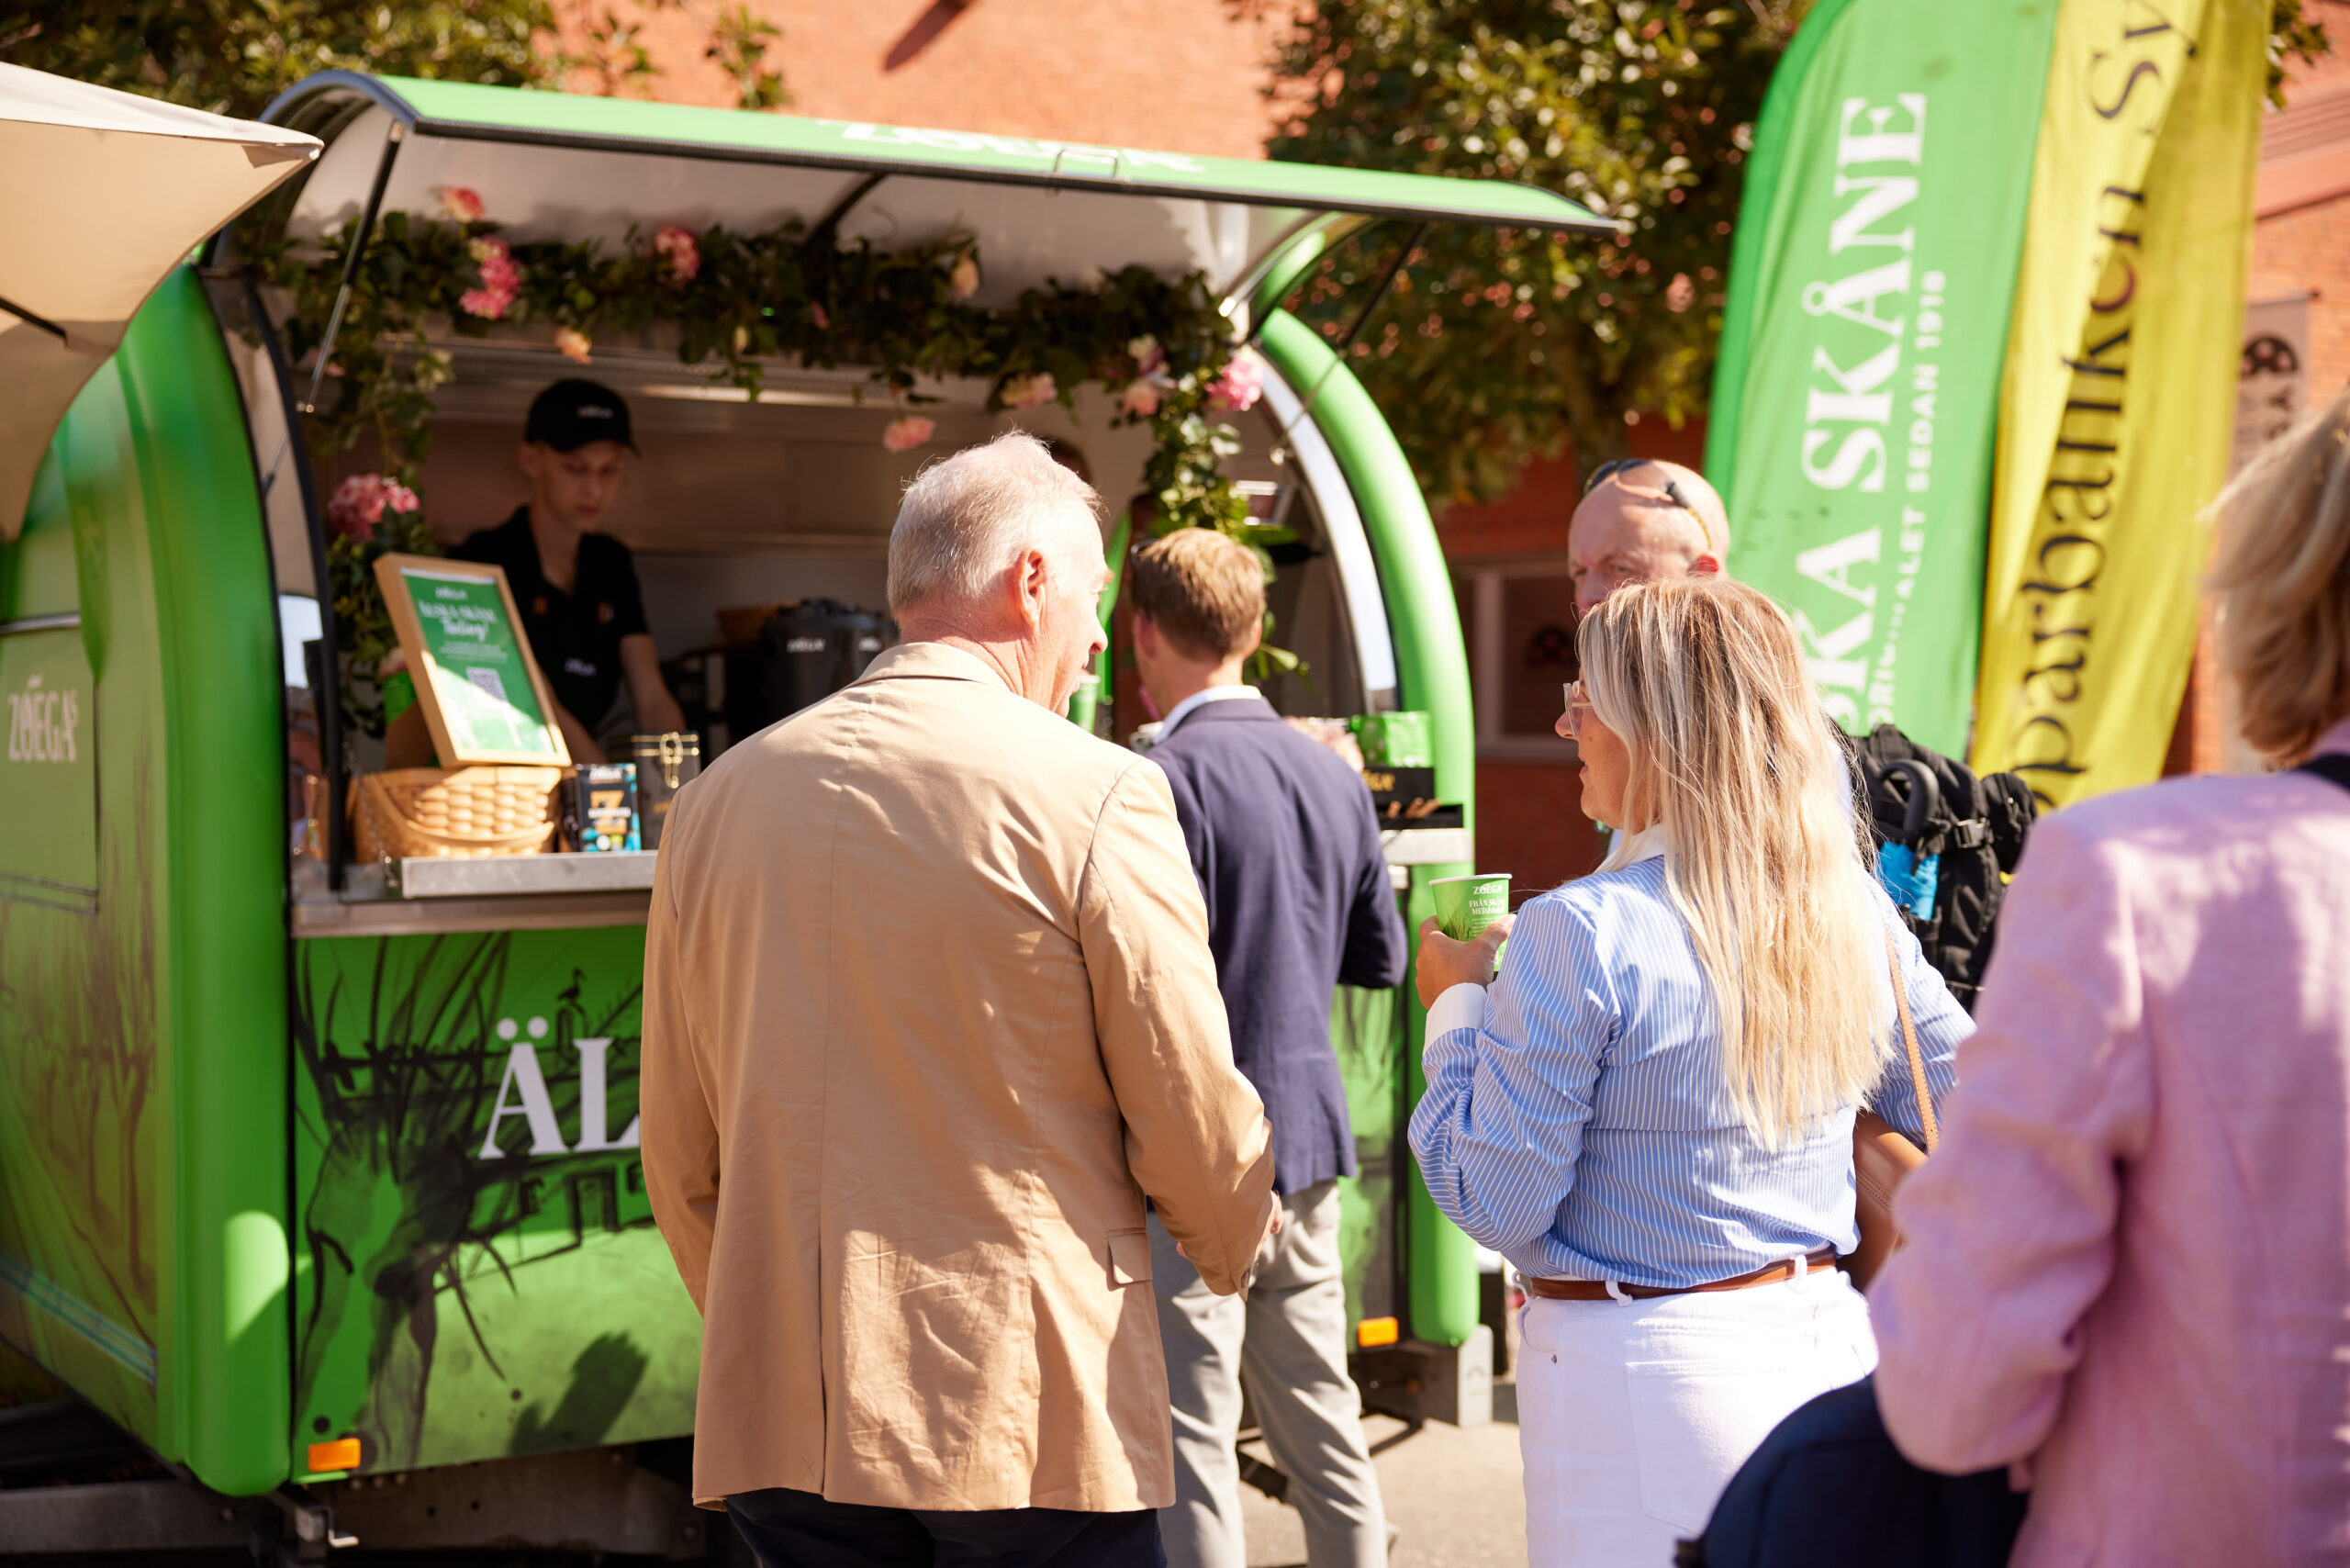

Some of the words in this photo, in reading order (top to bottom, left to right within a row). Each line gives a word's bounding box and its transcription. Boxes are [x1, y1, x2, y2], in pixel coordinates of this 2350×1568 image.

[1801, 93, 1927, 492] SKÅNE
[1915, 270, 1945, 350] 1918
[1906, 364, 1940, 493] SEDAN
